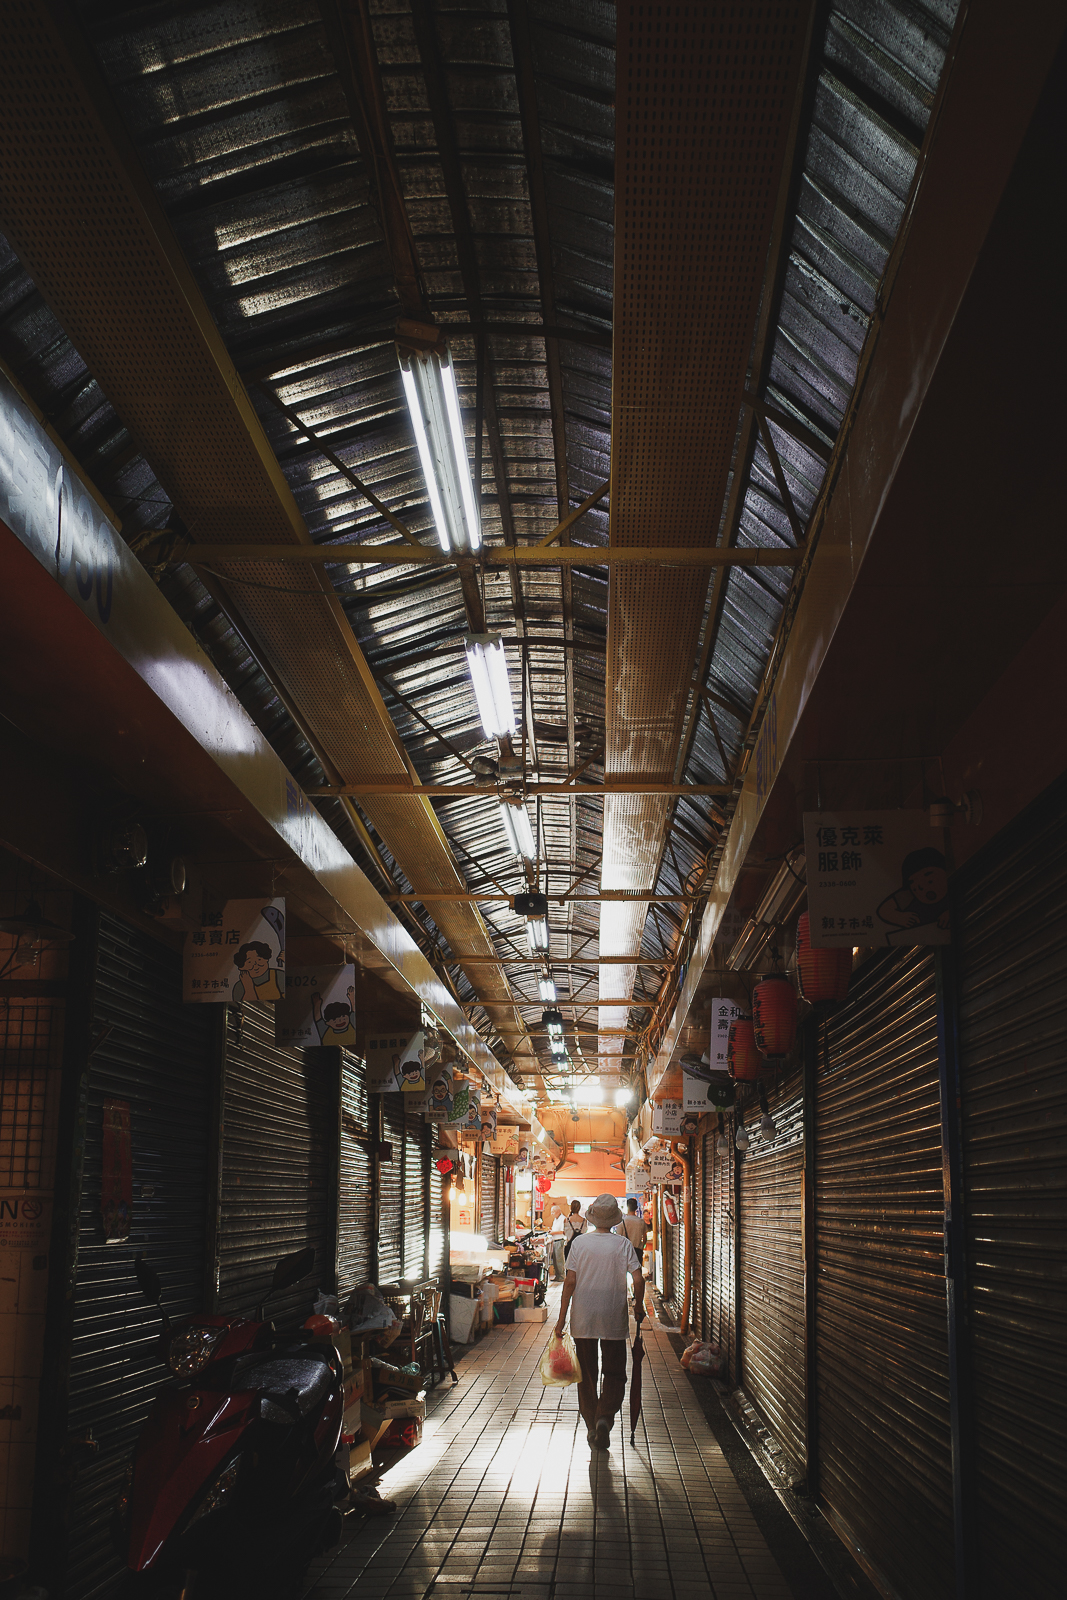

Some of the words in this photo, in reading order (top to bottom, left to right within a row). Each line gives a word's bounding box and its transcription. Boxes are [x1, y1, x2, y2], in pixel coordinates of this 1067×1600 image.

[816, 825, 884, 847] 優克萊
[818, 850, 862, 872] 服飾
[819, 880, 857, 888] 2338-0600
[821, 915, 874, 930] 親子市場
[191, 929, 241, 946] 專賣店
[191, 978, 230, 989] 親子市場
[718, 1005, 741, 1018] 金和
